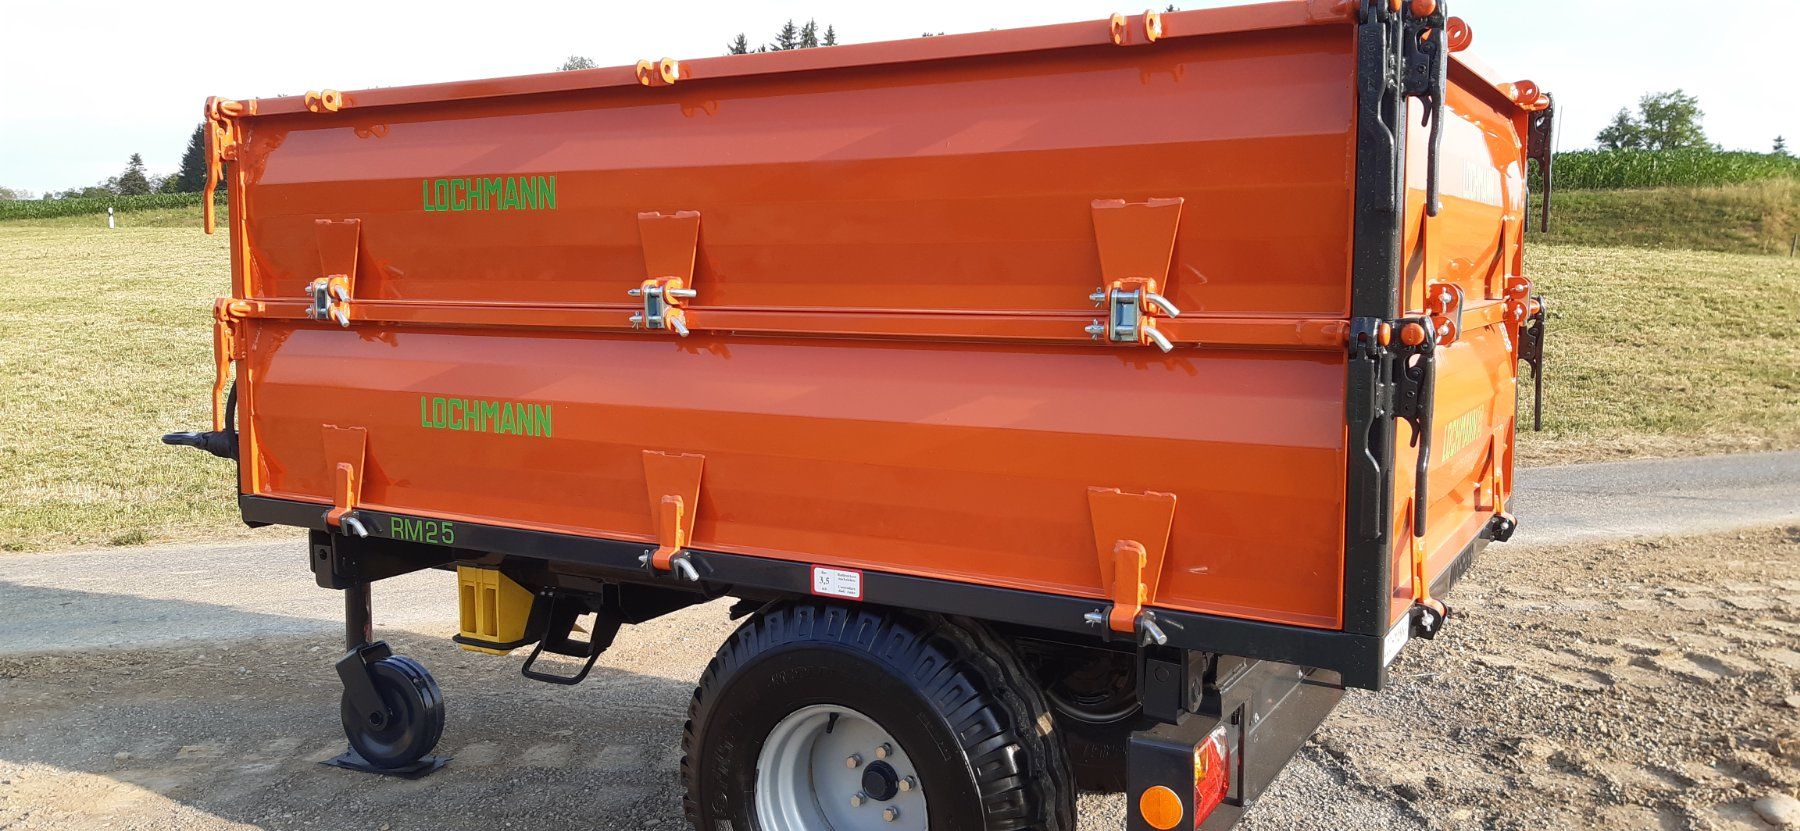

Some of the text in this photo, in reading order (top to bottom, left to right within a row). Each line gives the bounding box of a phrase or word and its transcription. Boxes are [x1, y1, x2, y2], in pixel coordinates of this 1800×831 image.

[423, 176, 556, 211] LOCHMANN
[421, 397, 551, 437] LOCHMANN
[390, 516, 455, 545] RM25
[819, 577, 830, 586] 3,5
